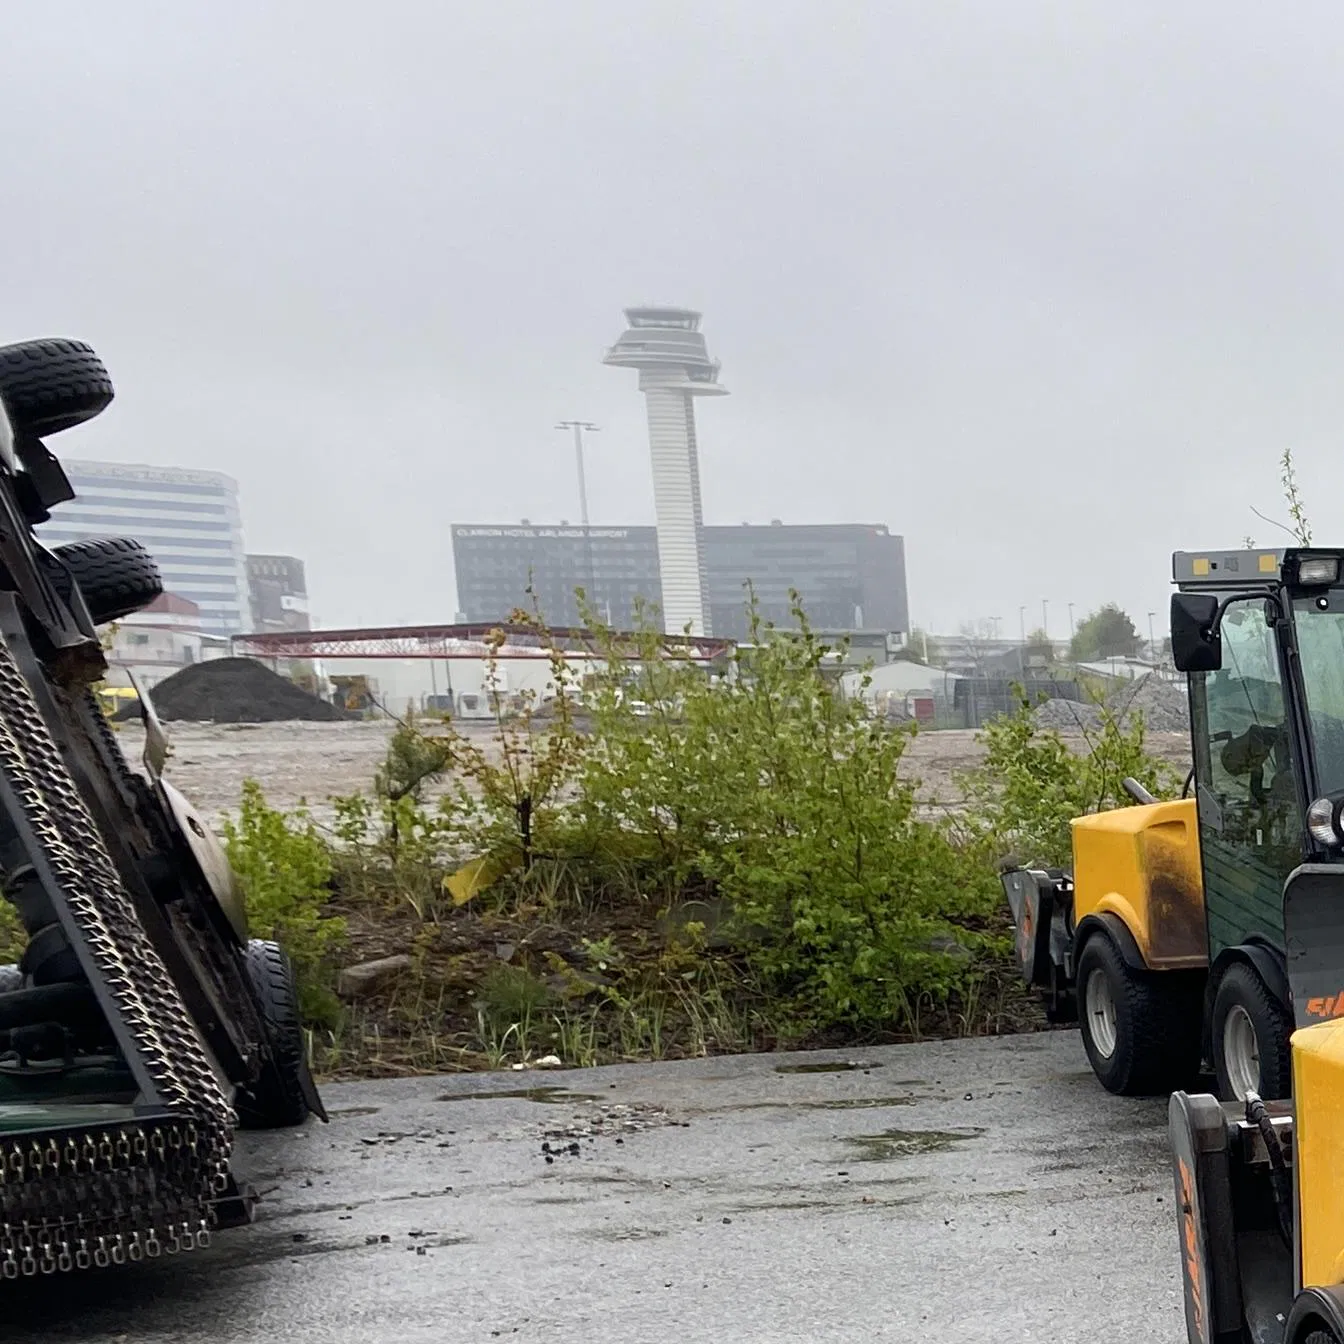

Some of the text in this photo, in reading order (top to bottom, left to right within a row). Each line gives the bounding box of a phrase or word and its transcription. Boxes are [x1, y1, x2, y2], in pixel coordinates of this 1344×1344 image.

[456, 528, 628, 538] CLARION HOTEL ARLANDA AIRPORT
